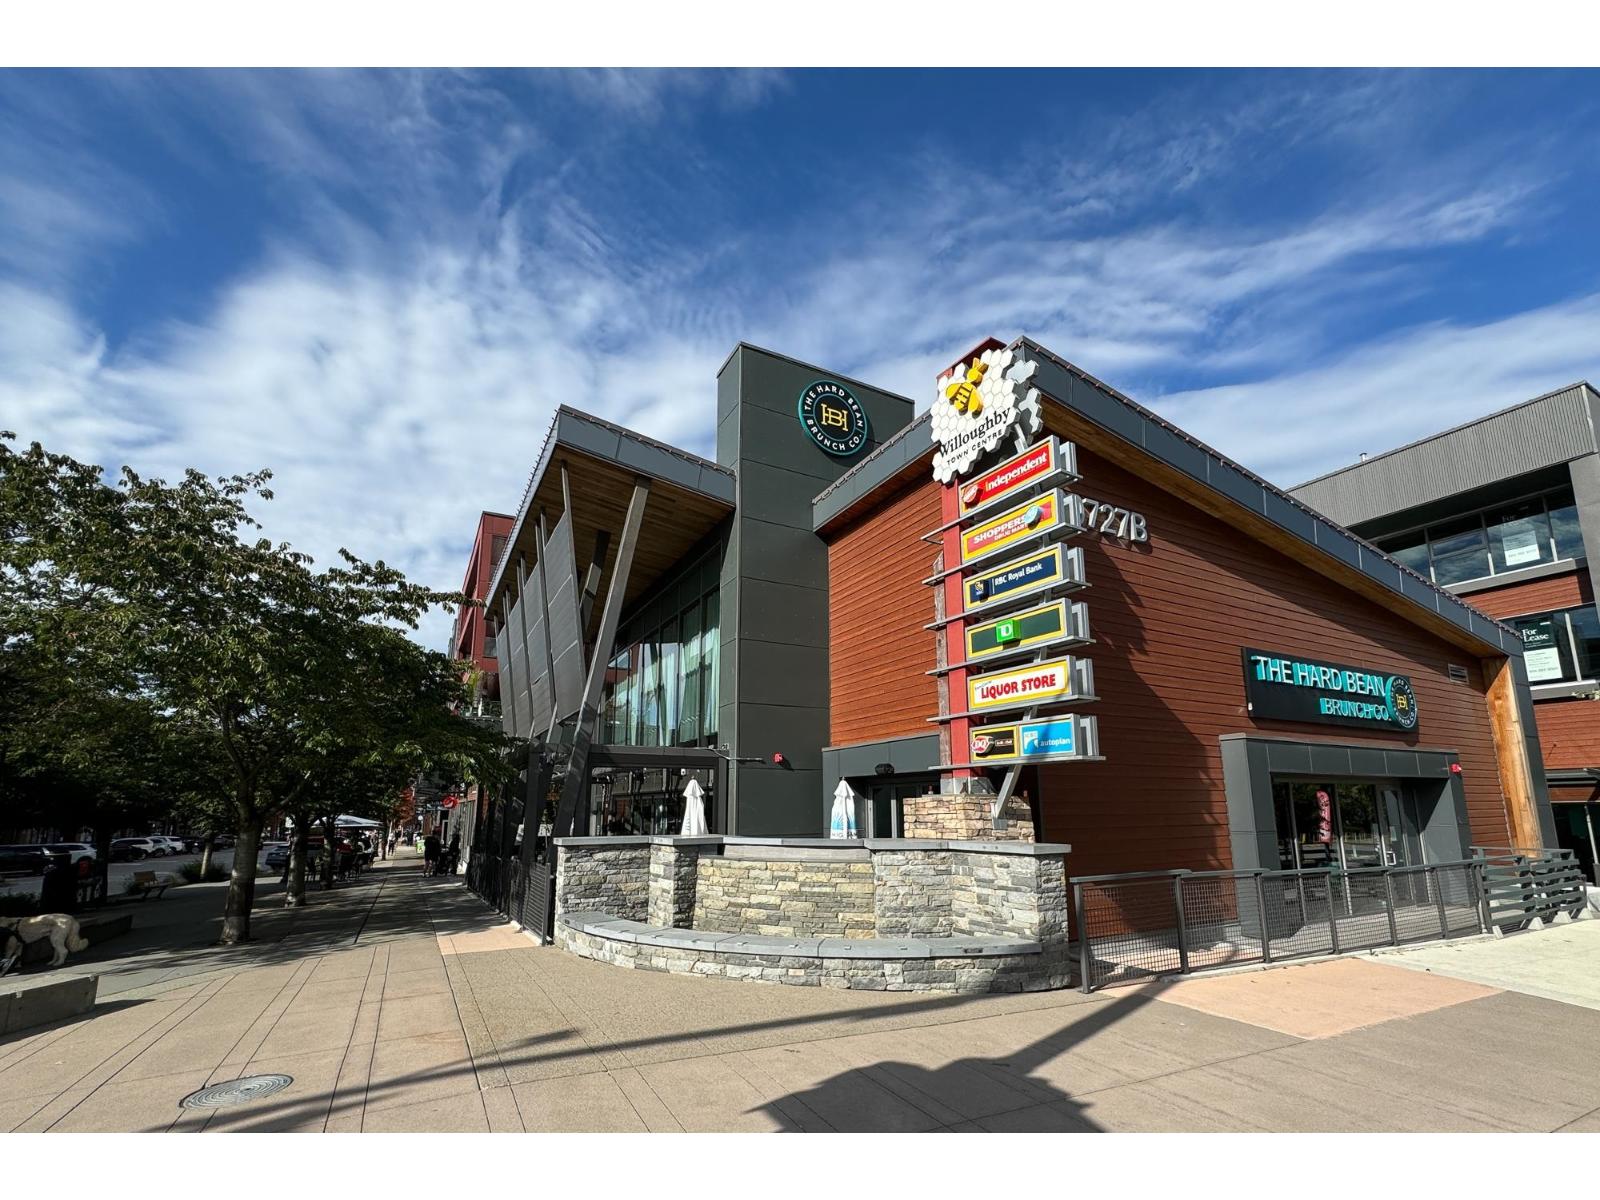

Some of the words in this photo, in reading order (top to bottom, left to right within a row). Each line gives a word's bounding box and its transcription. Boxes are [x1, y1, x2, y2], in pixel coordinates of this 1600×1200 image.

[804, 391, 816, 411] THE
[816, 385, 845, 397] HARD
[847, 398, 863, 427] BEAN
[807, 419, 846, 450] BRUNCH
[939, 407, 1011, 458] Willoughby
[946, 449, 969, 466] TOWN
[971, 428, 1003, 451] CENTRE
[994, 575, 1008, 586] RBC
[1008, 569, 1026, 581] Royal
[1026, 563, 1043, 575] Bank
[999, 624, 1012, 637] TD
[1522, 629, 1537, 637] For
[1523, 634, 1549, 642] Lease
[981, 681, 1019, 699] LIQUOR
[1021, 674, 1056, 692] STORE
[1251, 655, 1293, 684] THE
[1292, 662, 1343, 691] HARD
[1341, 671, 1386, 698] BEAN
[1320, 698, 1373, 719] BRUNCH
[1040, 737, 1071, 747] autoplan
